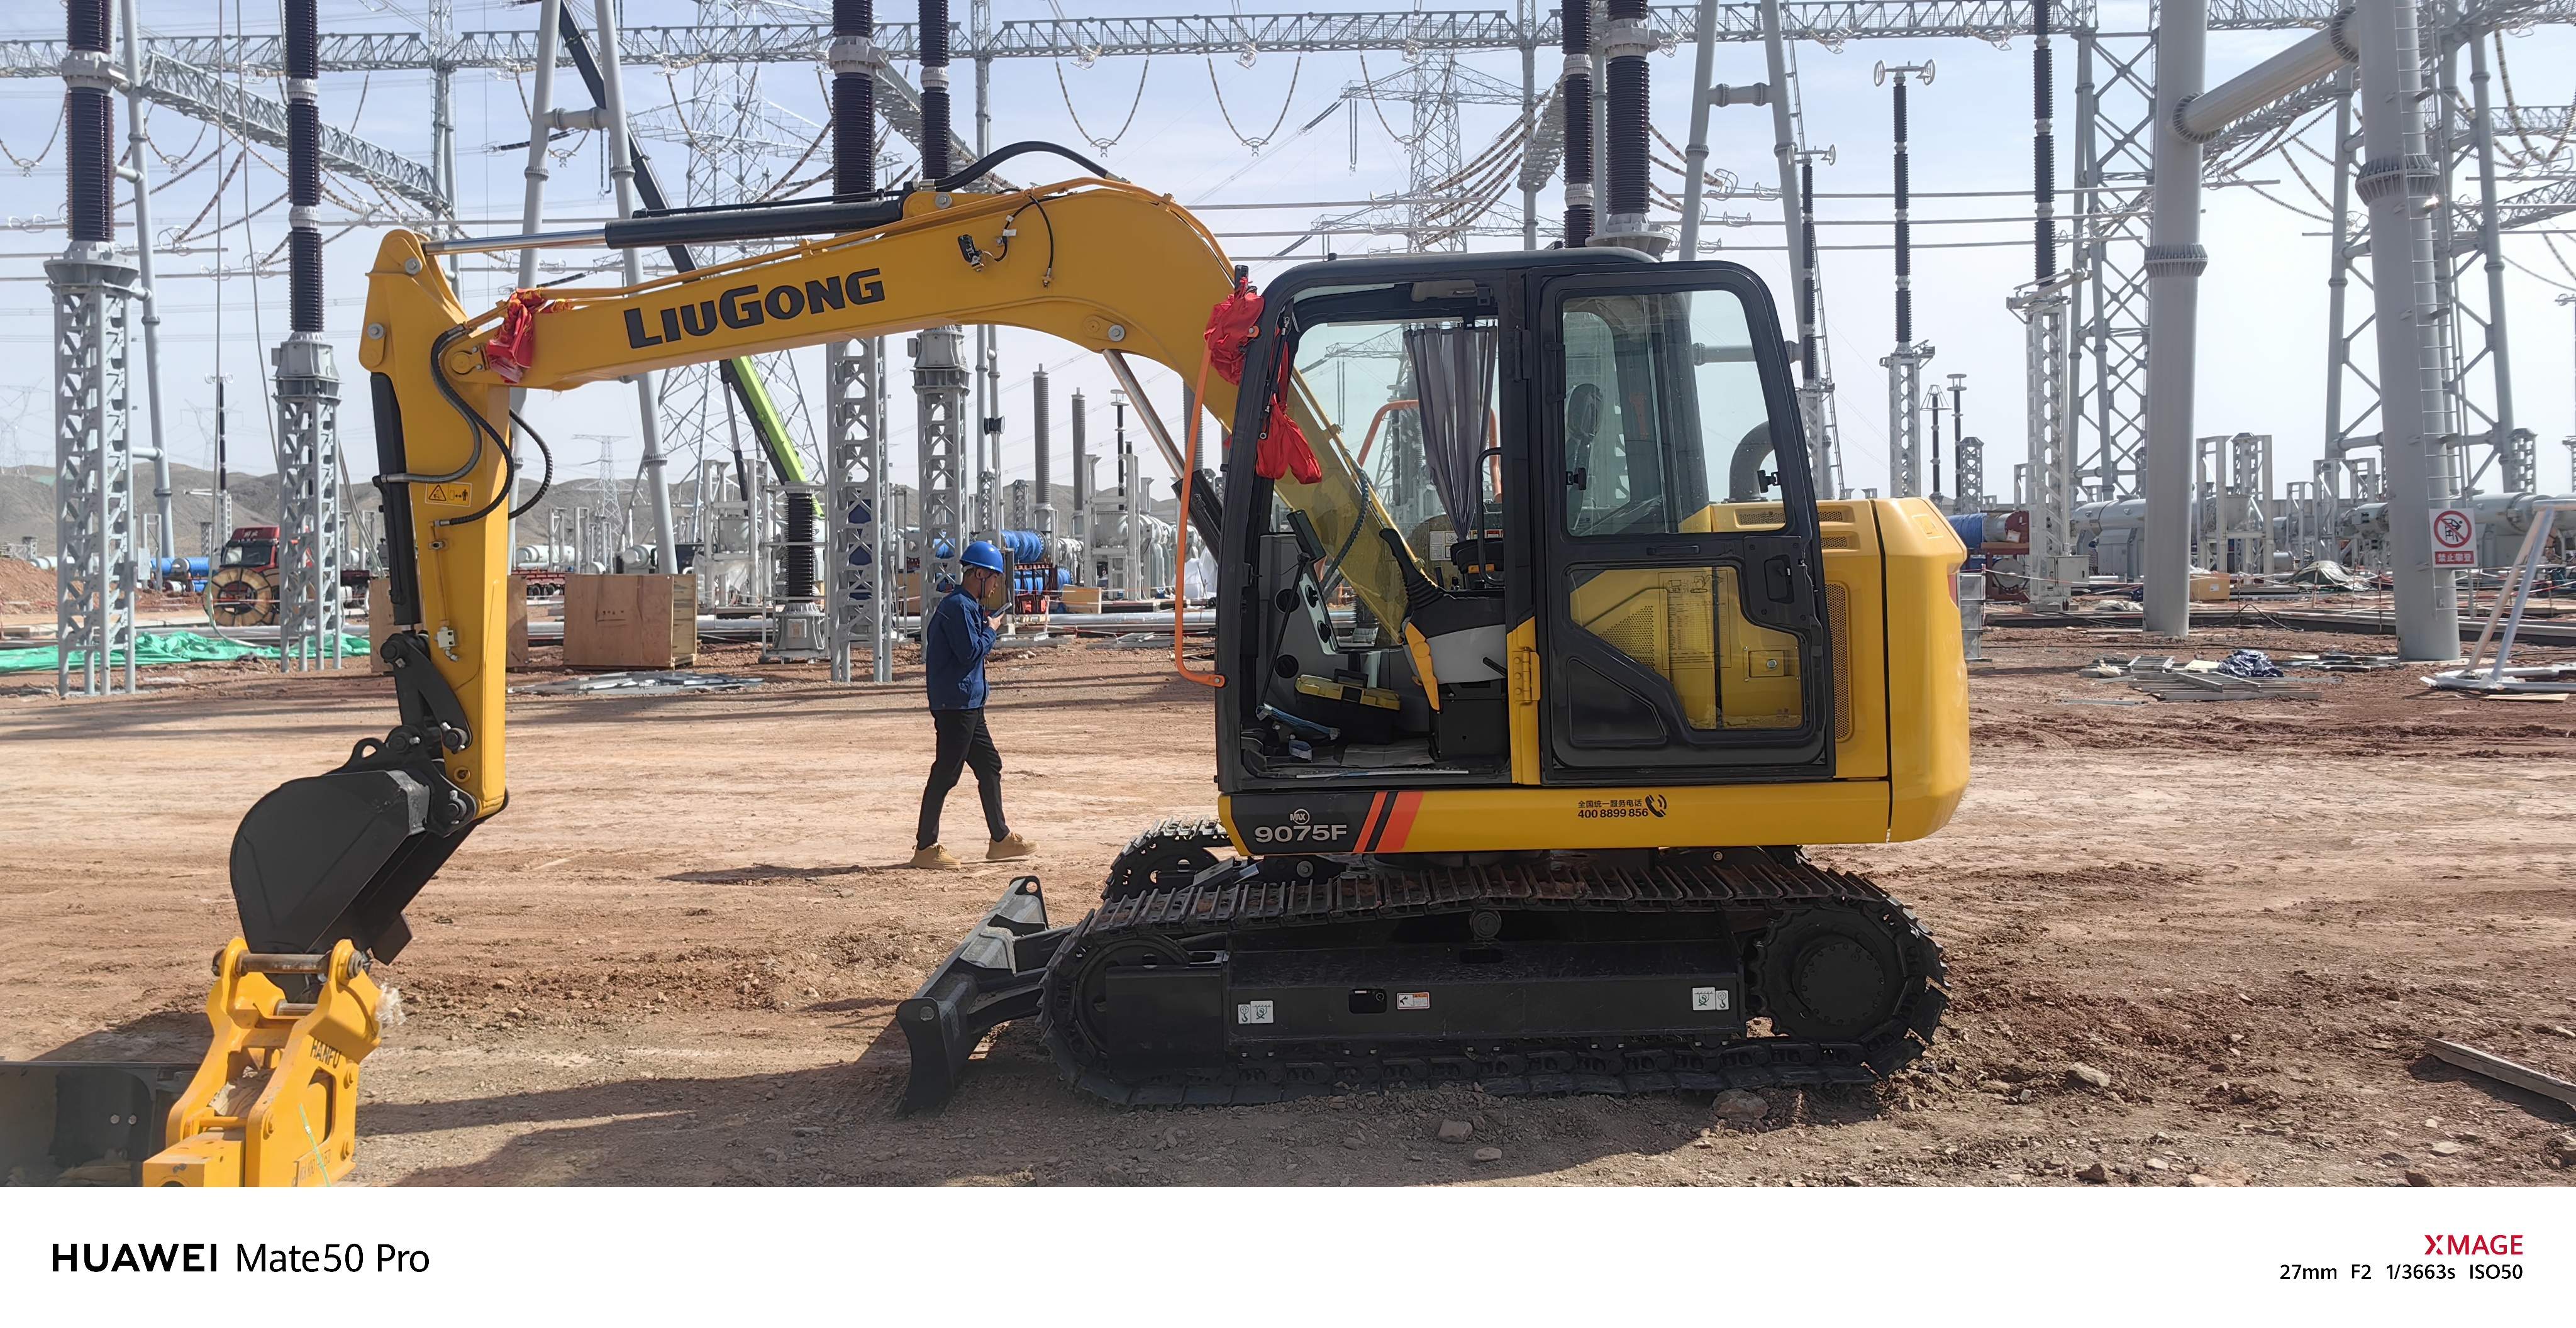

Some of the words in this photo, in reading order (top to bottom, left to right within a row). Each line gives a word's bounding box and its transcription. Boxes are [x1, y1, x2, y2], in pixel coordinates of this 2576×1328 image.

[1578, 799, 1642, 808] 全国统一服务电话
[1578, 809, 1598, 818] 400
[1599, 809, 1627, 818] 8899
[1628, 808, 1648, 817] 856
[1255, 825, 1347, 843] 9075F
